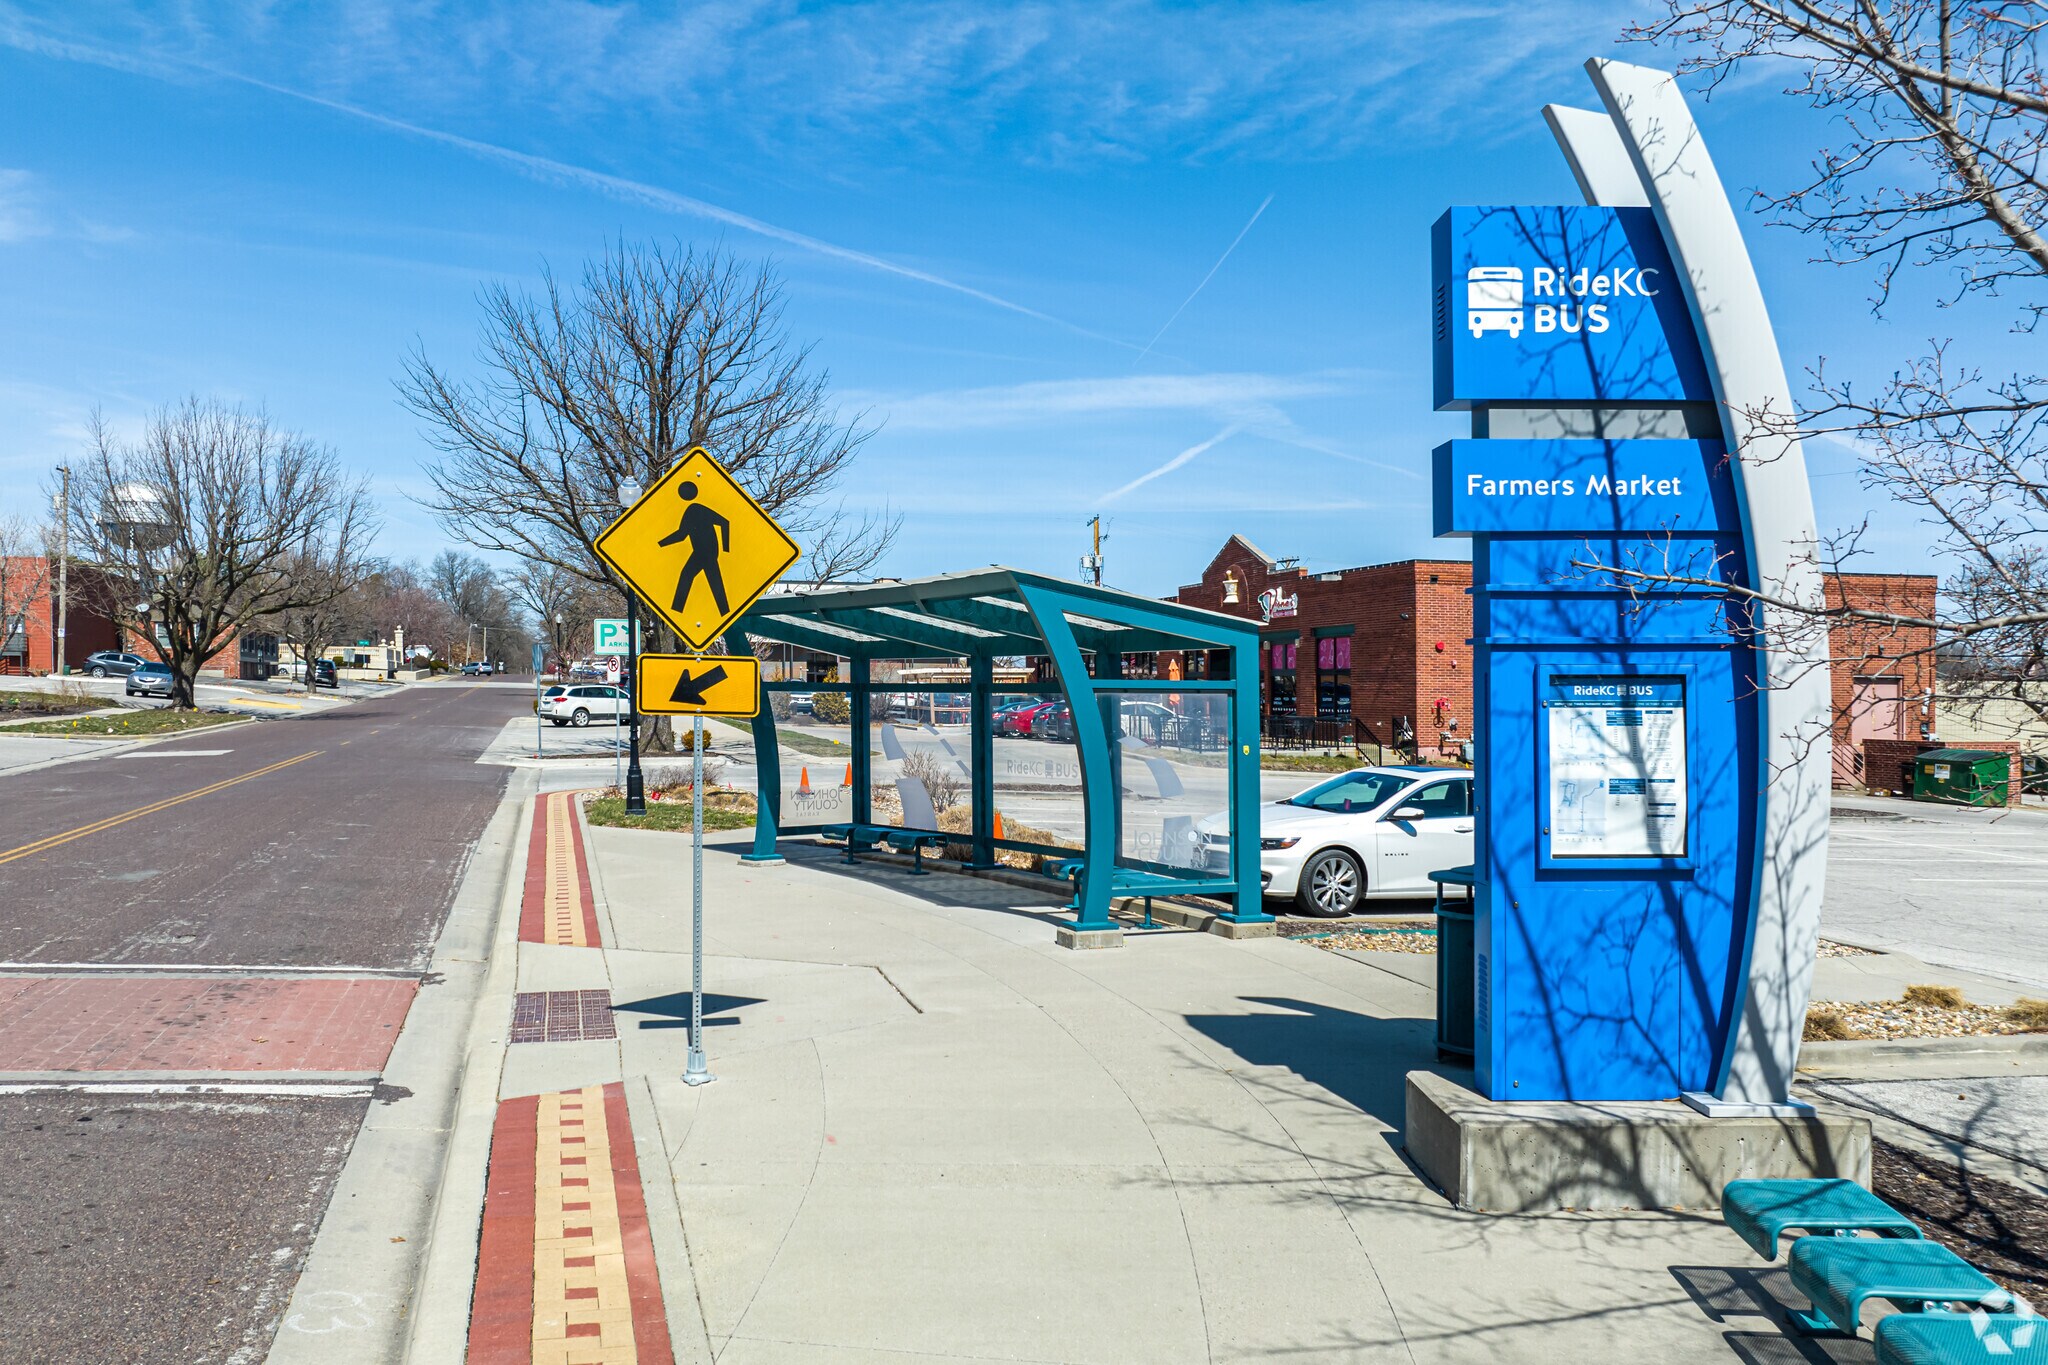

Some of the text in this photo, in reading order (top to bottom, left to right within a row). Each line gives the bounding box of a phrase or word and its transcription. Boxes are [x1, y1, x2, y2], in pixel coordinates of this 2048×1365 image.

[1533, 267, 1660, 297] RideKC
[1534, 304, 1610, 333] BUS
[1467, 474, 1682, 496] Farmers Market
[1573, 685, 1653, 696] RideKC BUS
[1007, 759, 1079, 778] RideKC BUS
